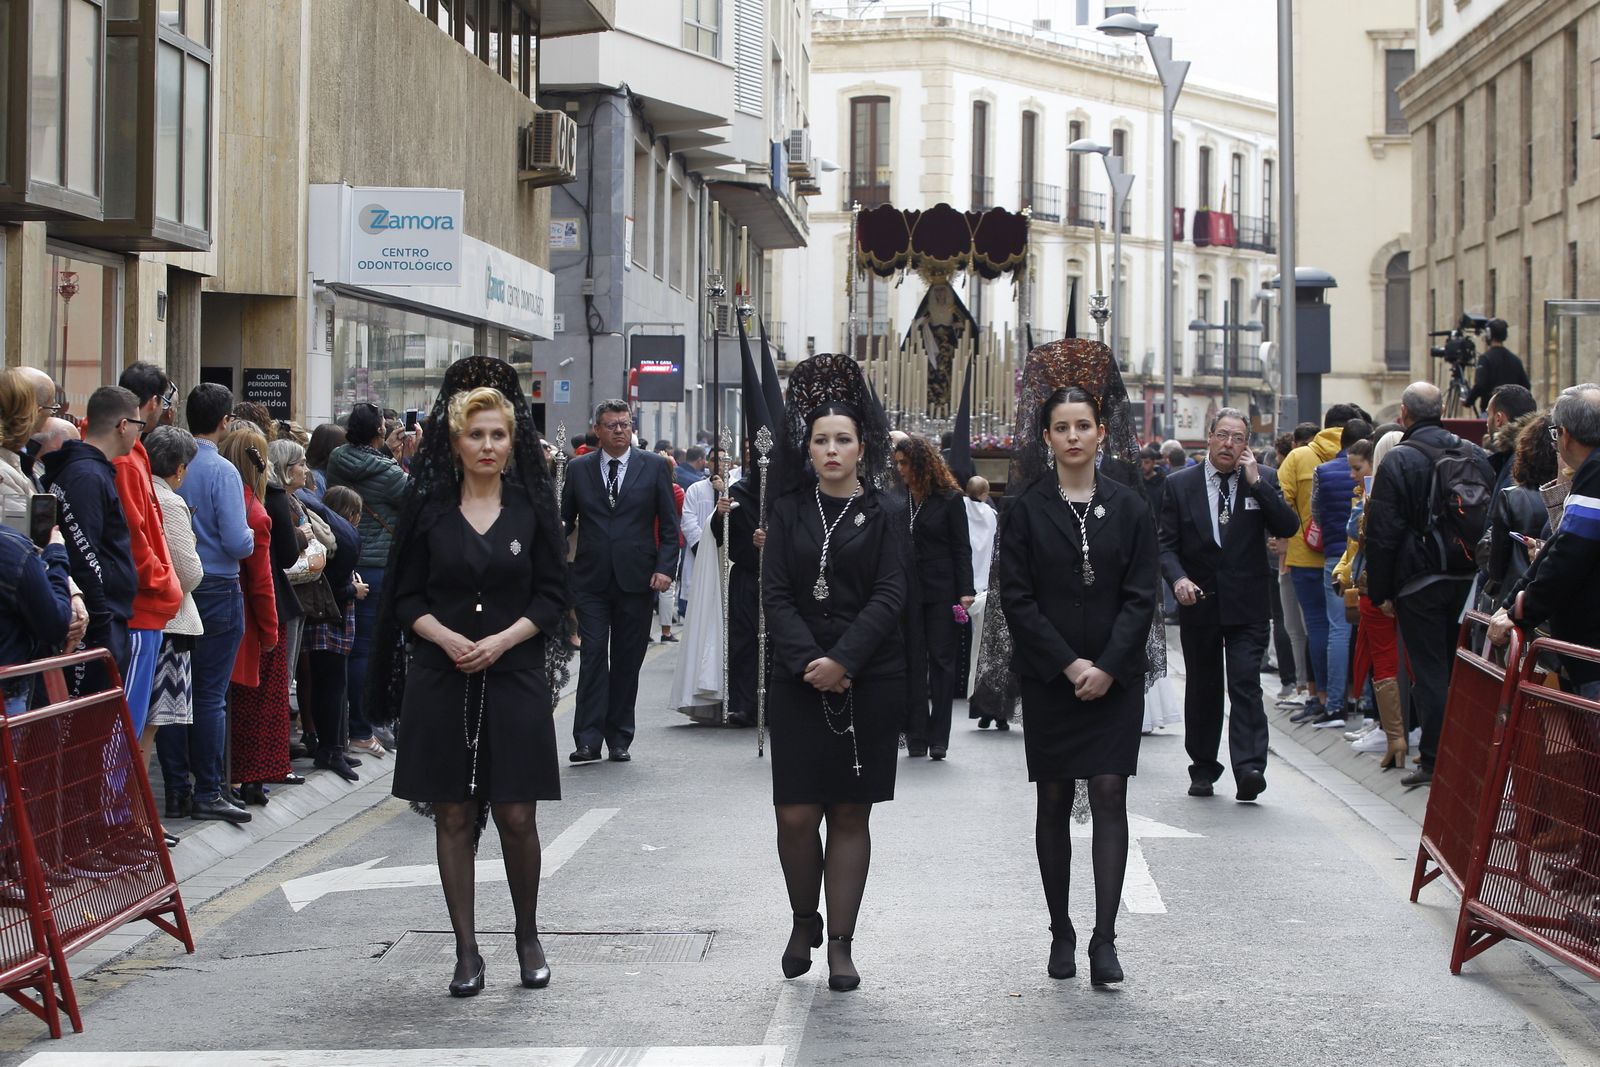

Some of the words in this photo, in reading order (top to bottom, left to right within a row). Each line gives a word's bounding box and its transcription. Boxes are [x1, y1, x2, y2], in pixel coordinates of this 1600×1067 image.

[370, 209, 454, 230] Zamora
[381, 247, 429, 258] CENTRO
[358, 259, 453, 272] ODONTOLÓGICO
